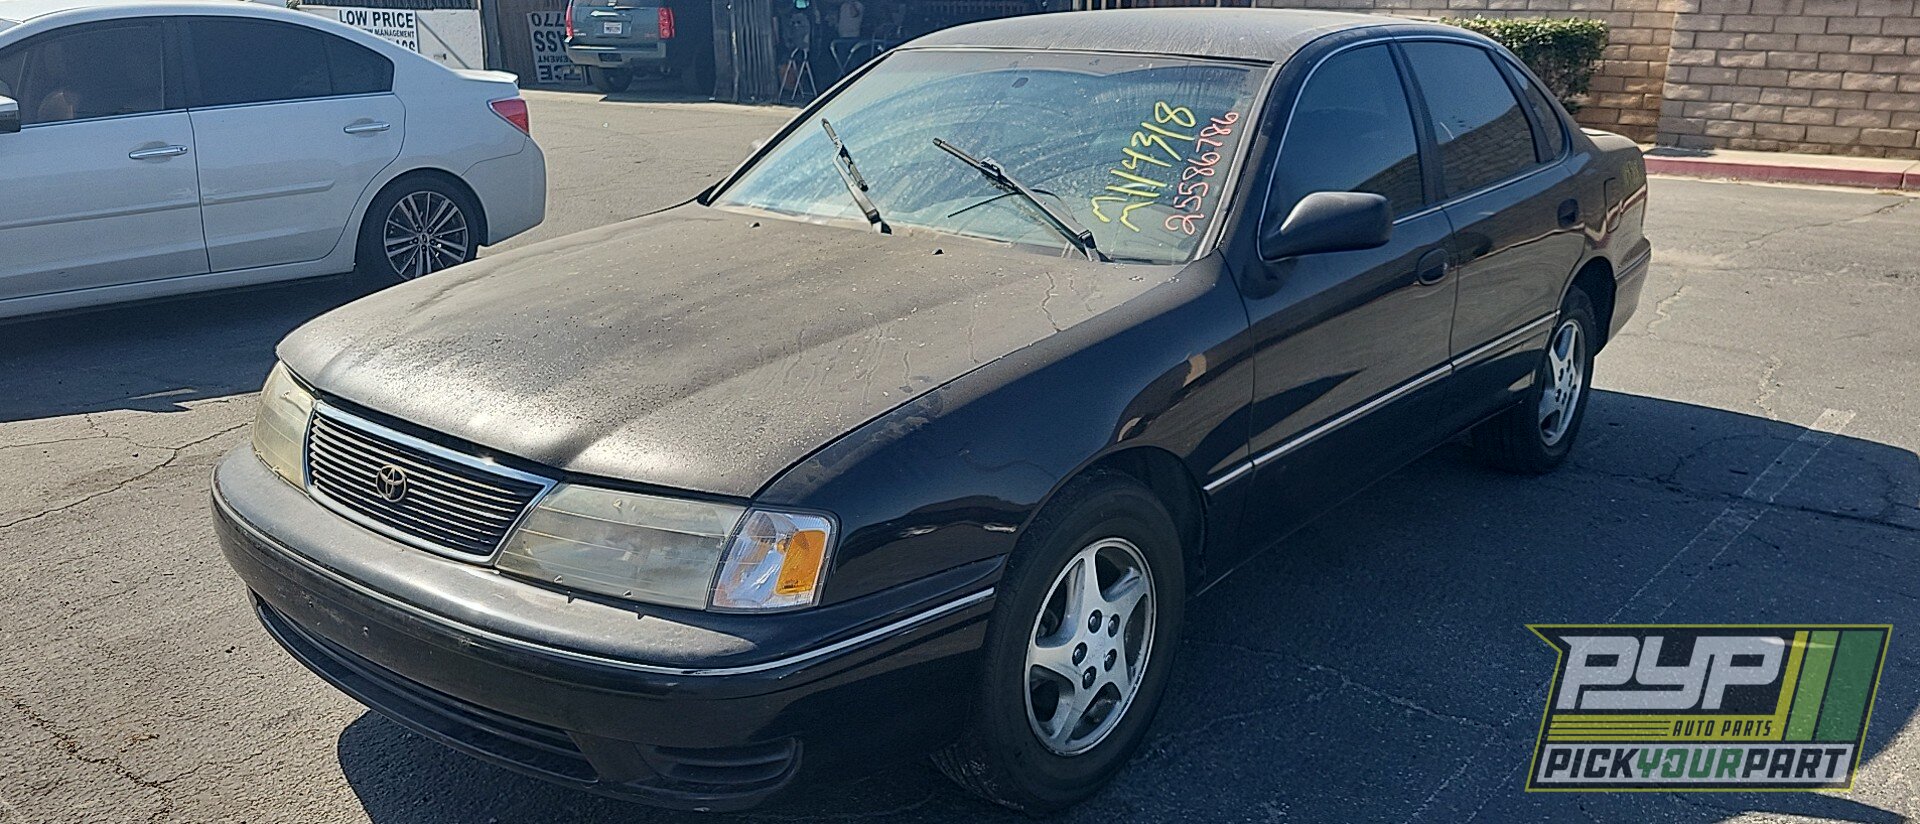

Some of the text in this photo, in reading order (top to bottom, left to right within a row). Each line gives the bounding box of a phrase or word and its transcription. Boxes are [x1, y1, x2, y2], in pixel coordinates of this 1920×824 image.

[339, 10, 414, 28] LOW PRICE
[374, 28, 415, 38] MANAGEMENT
[1165, 111, 1239, 235] 25586786
